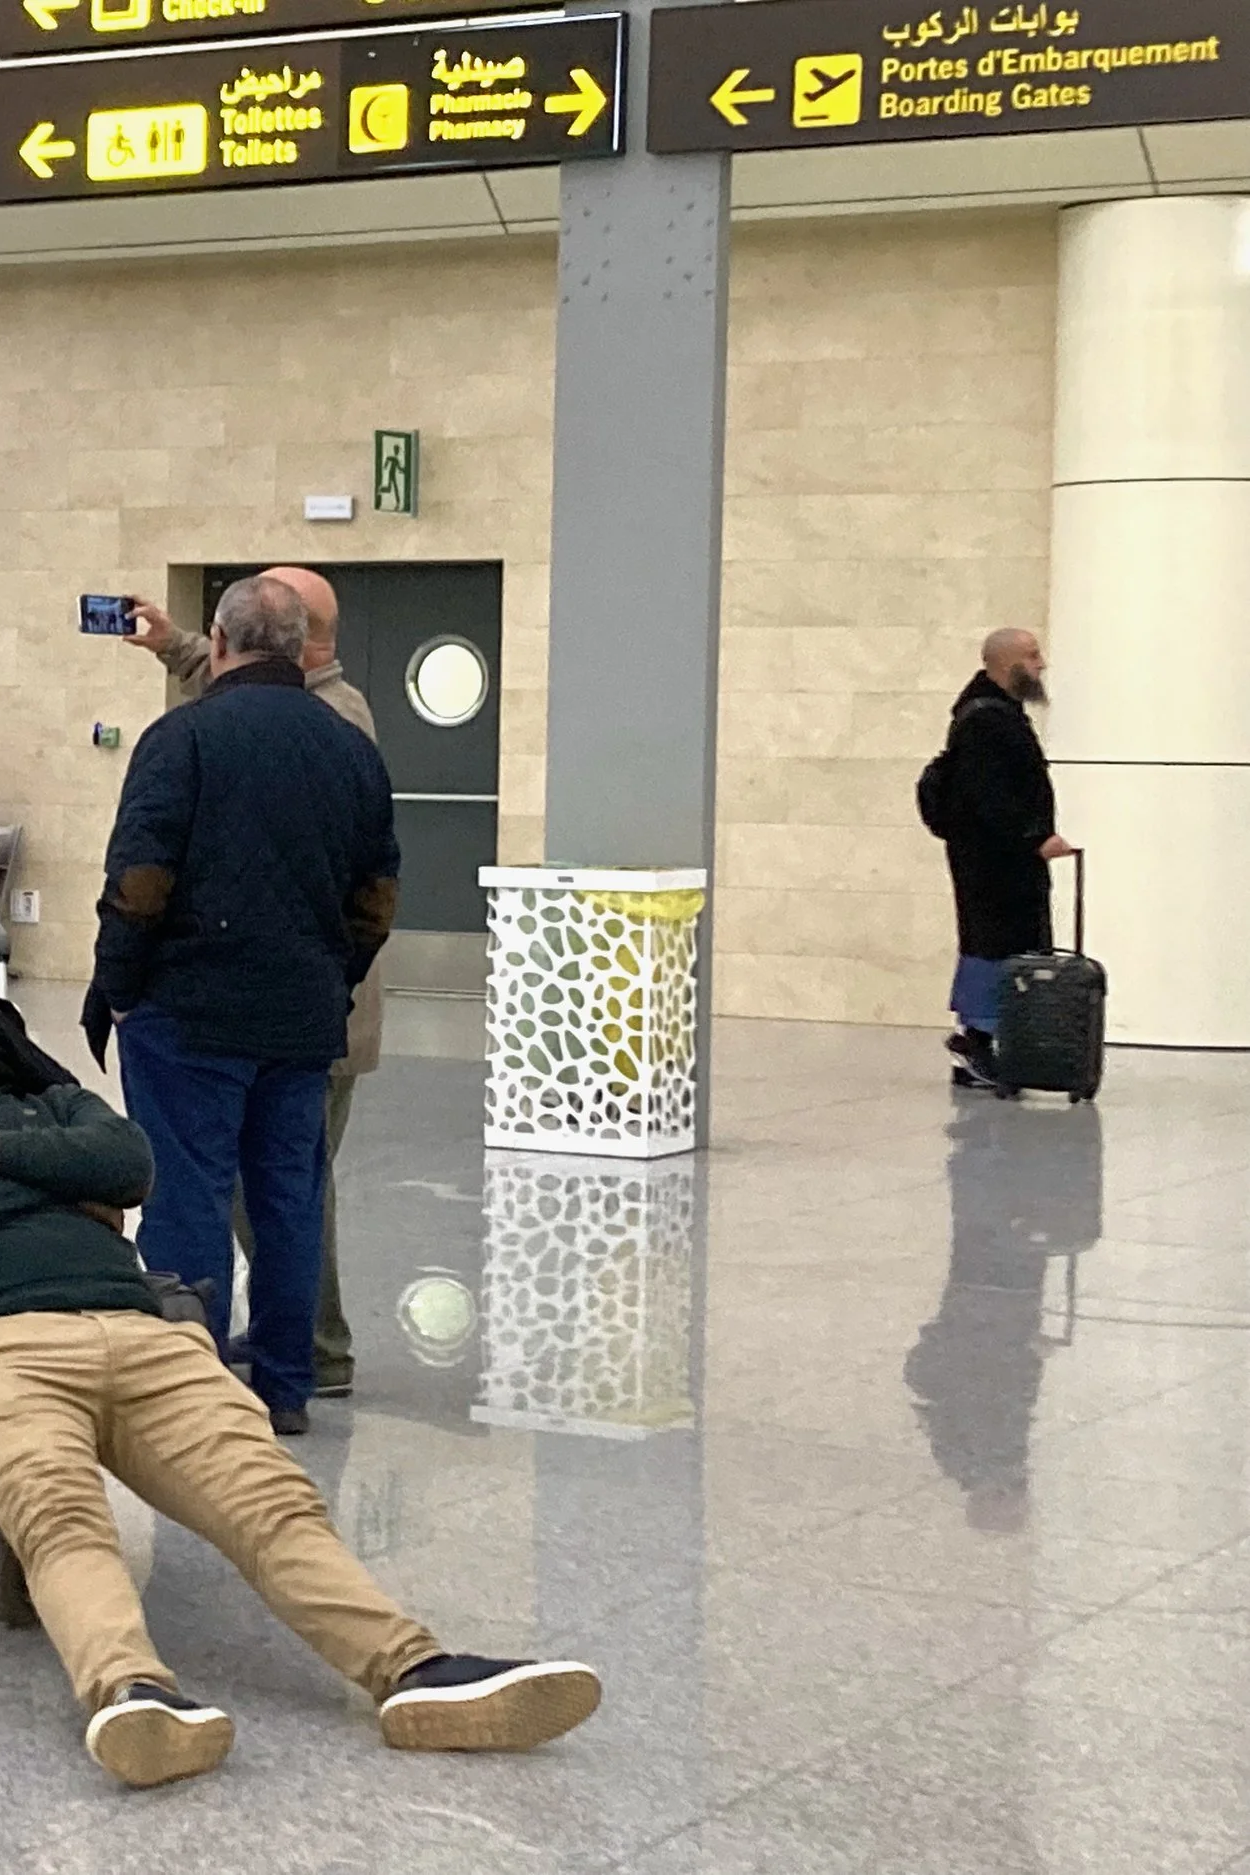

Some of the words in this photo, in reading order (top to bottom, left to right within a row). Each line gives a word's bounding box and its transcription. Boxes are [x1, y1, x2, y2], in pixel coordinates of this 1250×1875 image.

[882, 6, 979, 48] الركوب
[989, 2, 1079, 38] بوابات
[881, 57, 969, 84] Portes
[977, 36, 1220, 77] d'Embarquement
[879, 87, 1003, 119] Boarding
[1011, 82, 1092, 110] Gates
[220, 106, 322, 135] Toilettes
[429, 119, 525, 141] Pharmacy
[219, 138, 298, 167] Toilets
